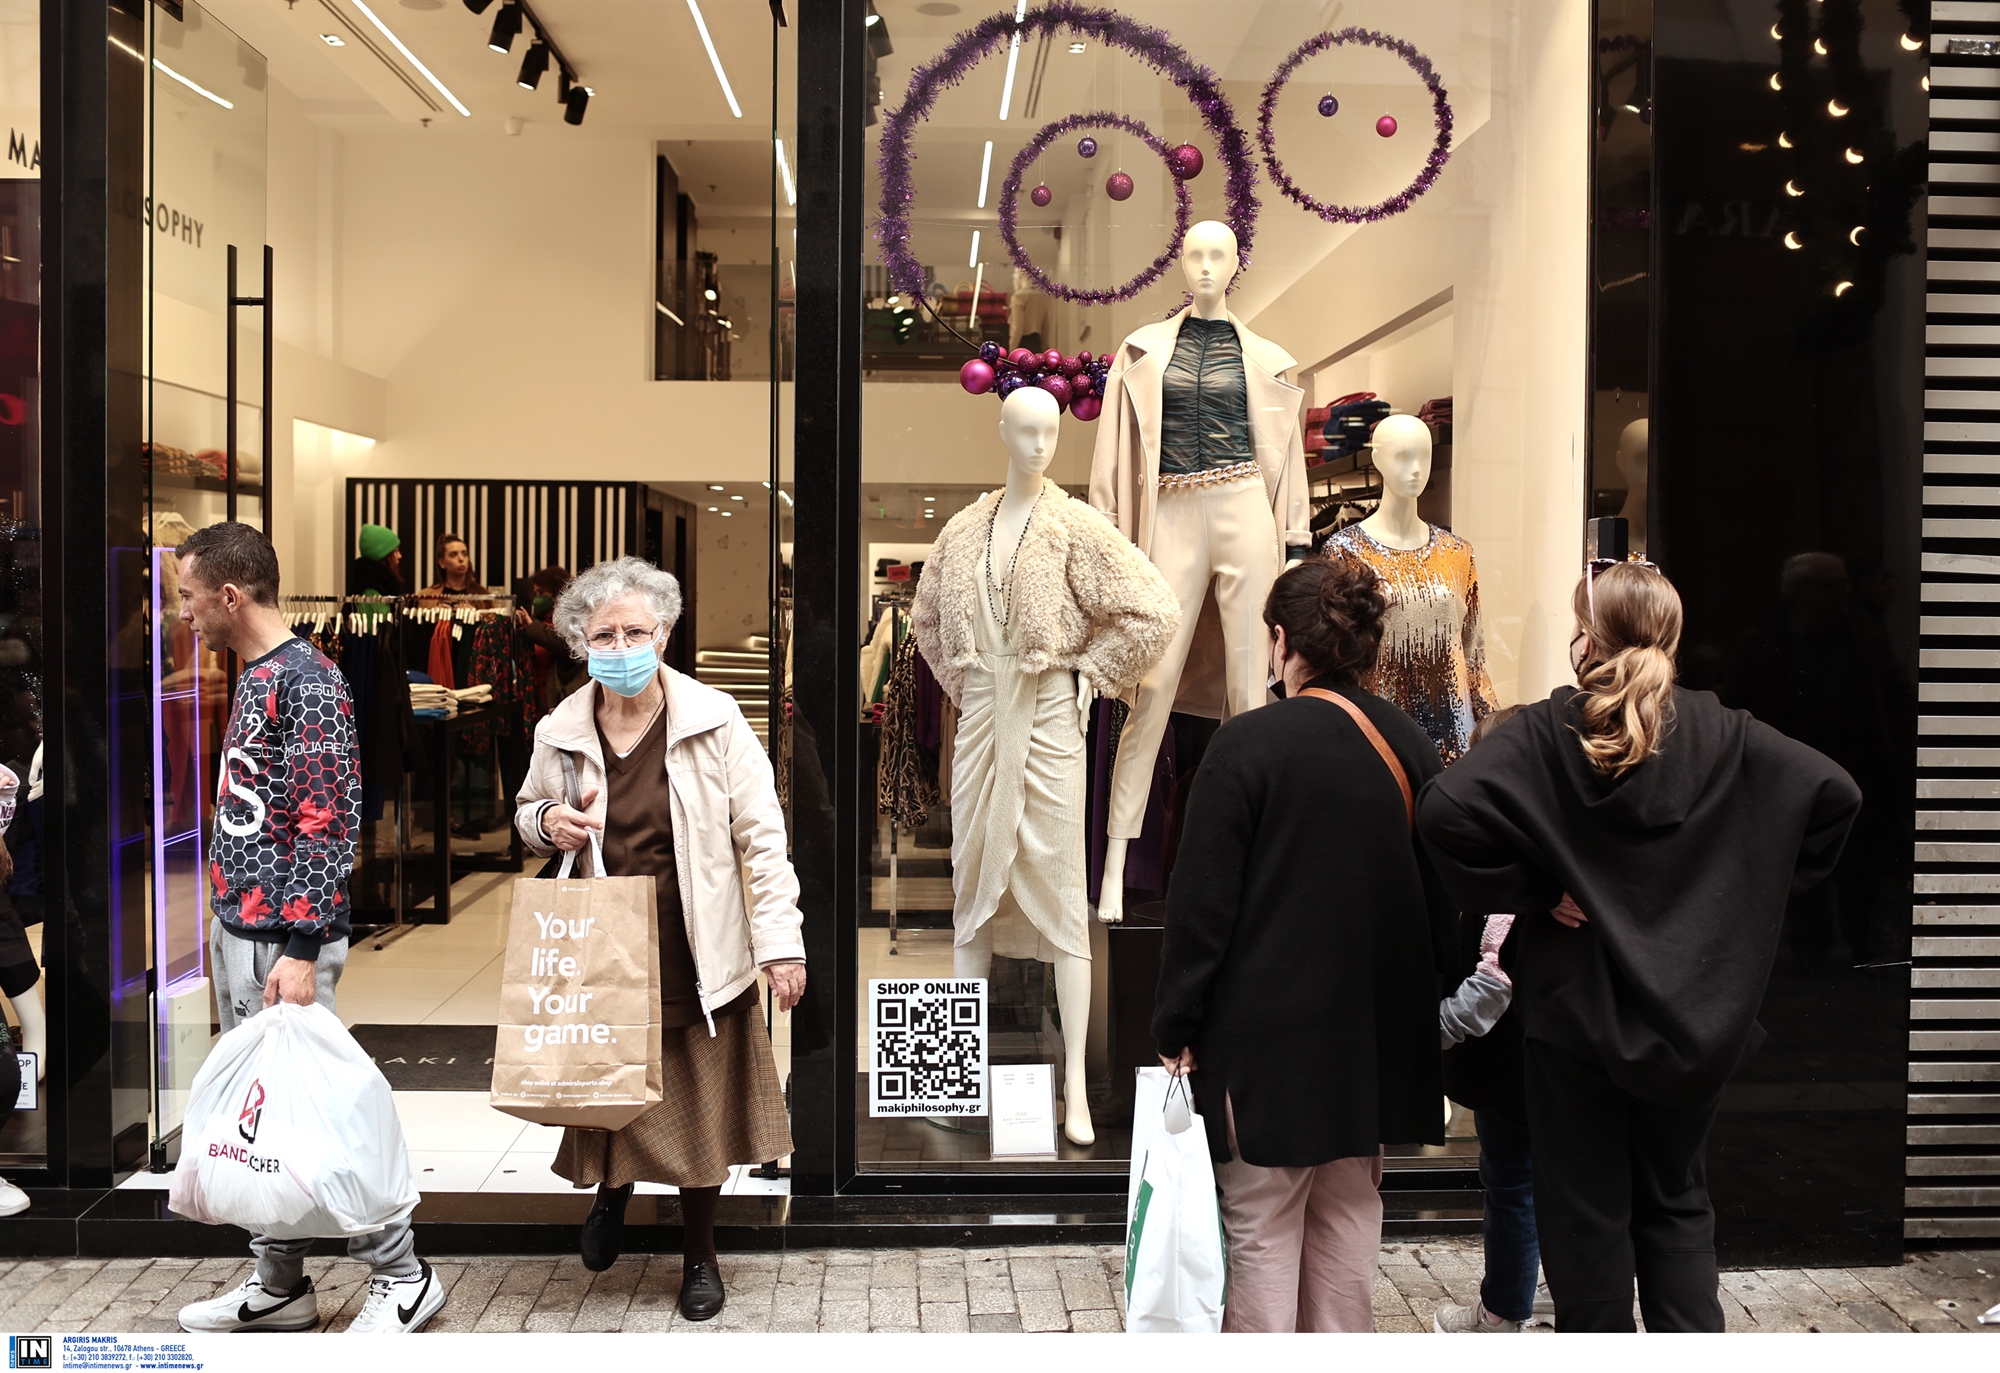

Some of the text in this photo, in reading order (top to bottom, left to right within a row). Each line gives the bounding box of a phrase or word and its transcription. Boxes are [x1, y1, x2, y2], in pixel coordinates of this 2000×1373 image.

[533, 911, 595, 940] Your
[531, 947, 581, 977] life.
[527, 986, 593, 1015] Your
[877, 982, 981, 995] SHOP ONLINE
[523, 1021, 618, 1053] game.
[877, 1103, 982, 1114] makiphilosophy.gr
